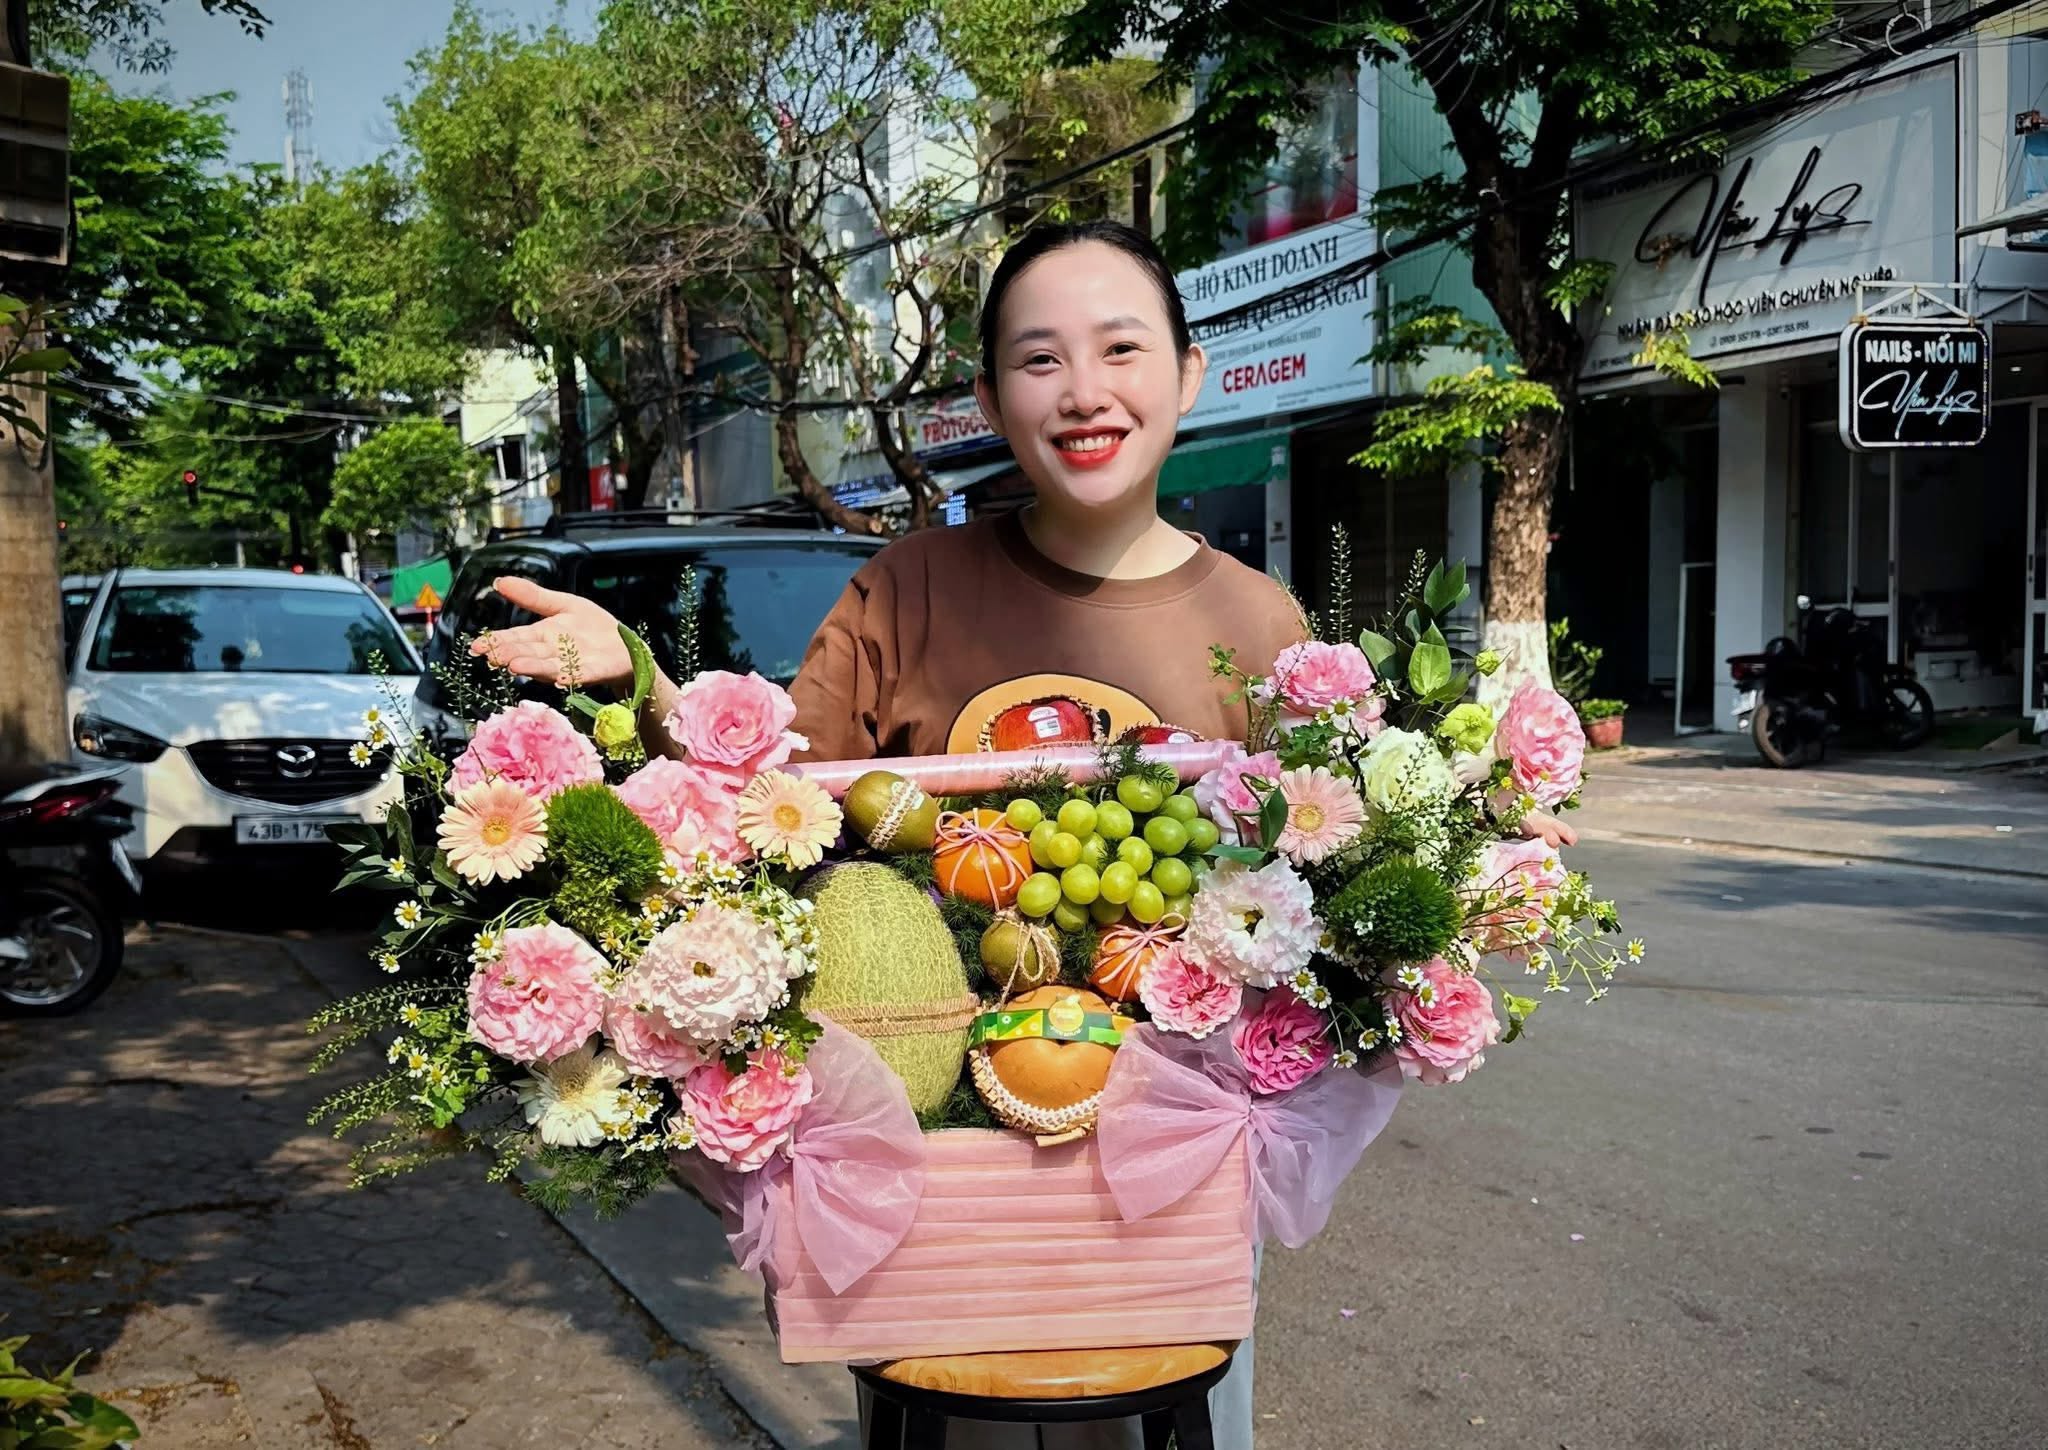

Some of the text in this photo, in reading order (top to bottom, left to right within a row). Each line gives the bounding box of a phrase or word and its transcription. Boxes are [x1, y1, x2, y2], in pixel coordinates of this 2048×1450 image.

[1223, 256, 1267, 294] KINH
[1272, 235, 1339, 279] DOANH
[1714, 300, 1743, 323] HỌC
[1780, 279, 1835, 307] CHUYÊN
[1865, 340, 1912, 363] NAILS
[1924, 333, 1954, 363] NỐI
[1958, 341, 1977, 363] MI
[1222, 353, 1306, 394] CERAGEM
[248, 823, 325, 840] 43B-175
